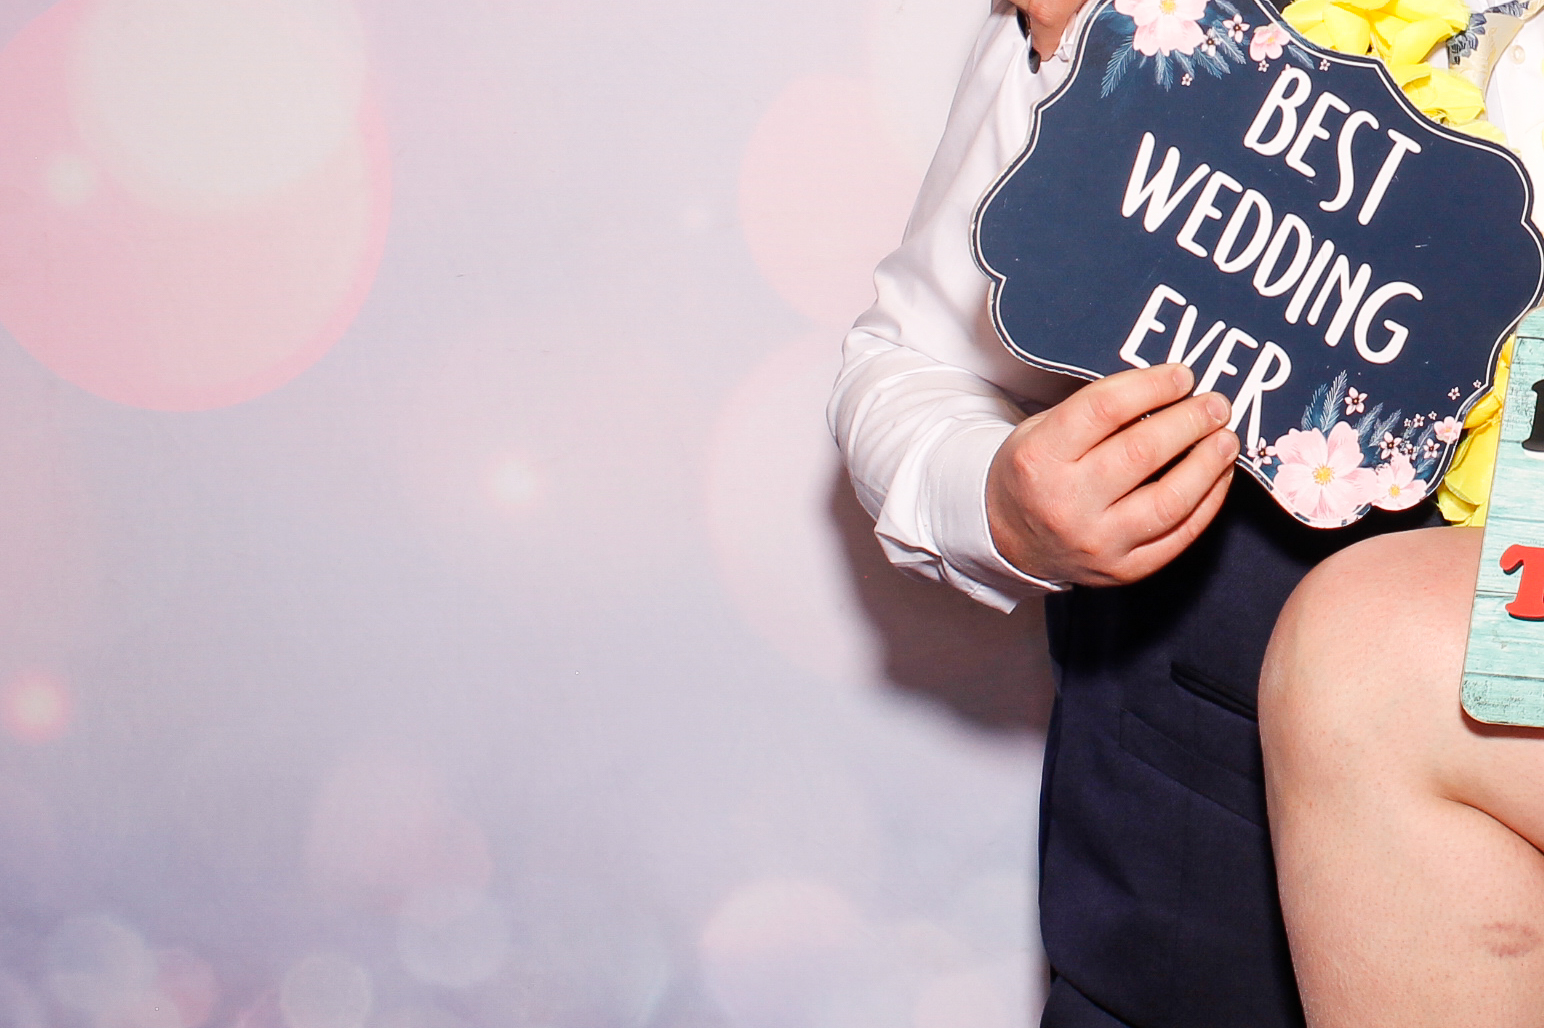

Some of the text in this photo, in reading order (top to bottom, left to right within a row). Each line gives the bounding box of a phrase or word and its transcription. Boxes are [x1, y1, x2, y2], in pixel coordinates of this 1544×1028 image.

[1243, 67, 1422, 226] BEST
[1121, 131, 1424, 364] WEDDING
[1119, 284, 1292, 450] EVER
